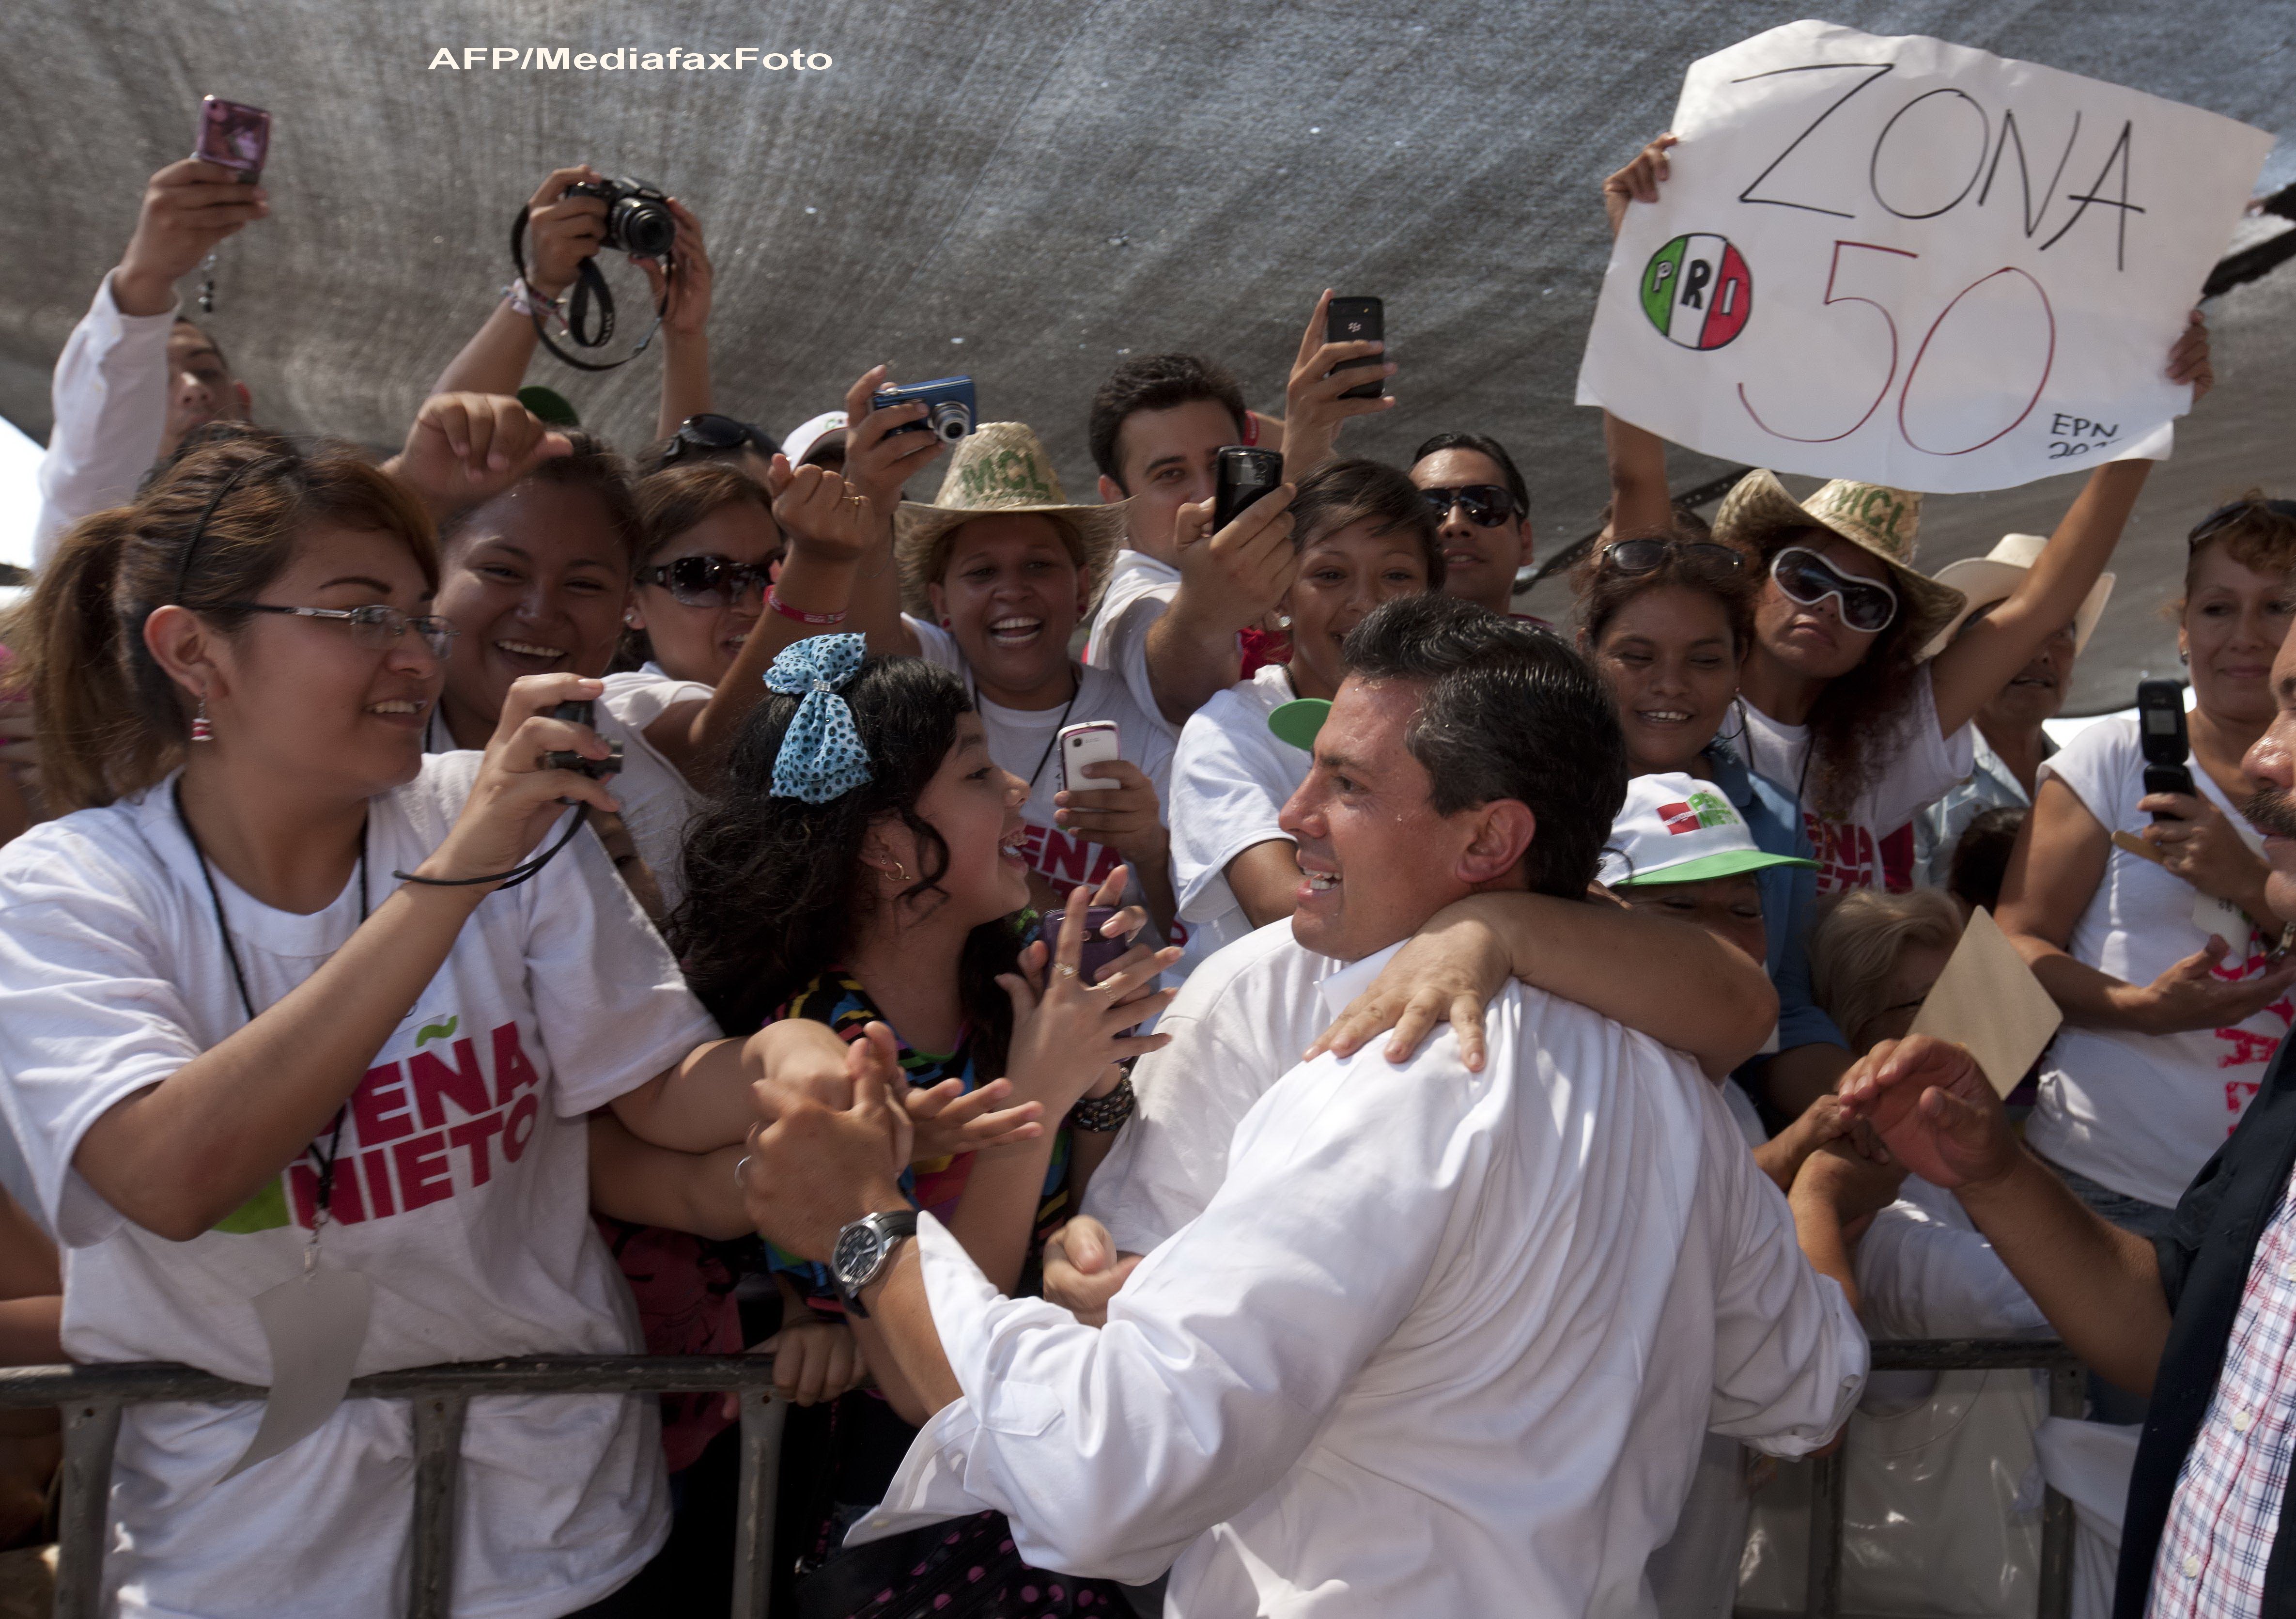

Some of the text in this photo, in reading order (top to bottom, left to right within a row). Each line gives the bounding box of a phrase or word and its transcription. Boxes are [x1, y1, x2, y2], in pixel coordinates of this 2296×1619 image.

[1730, 63, 2145, 271] ZONA
[1652, 259, 1739, 316] PRI
[1737, 240, 2055, 455] 50
[2048, 436, 2125, 459] 20
[2051, 413, 2119, 437] EPN
[290, 1093, 538, 1231] NIETO
